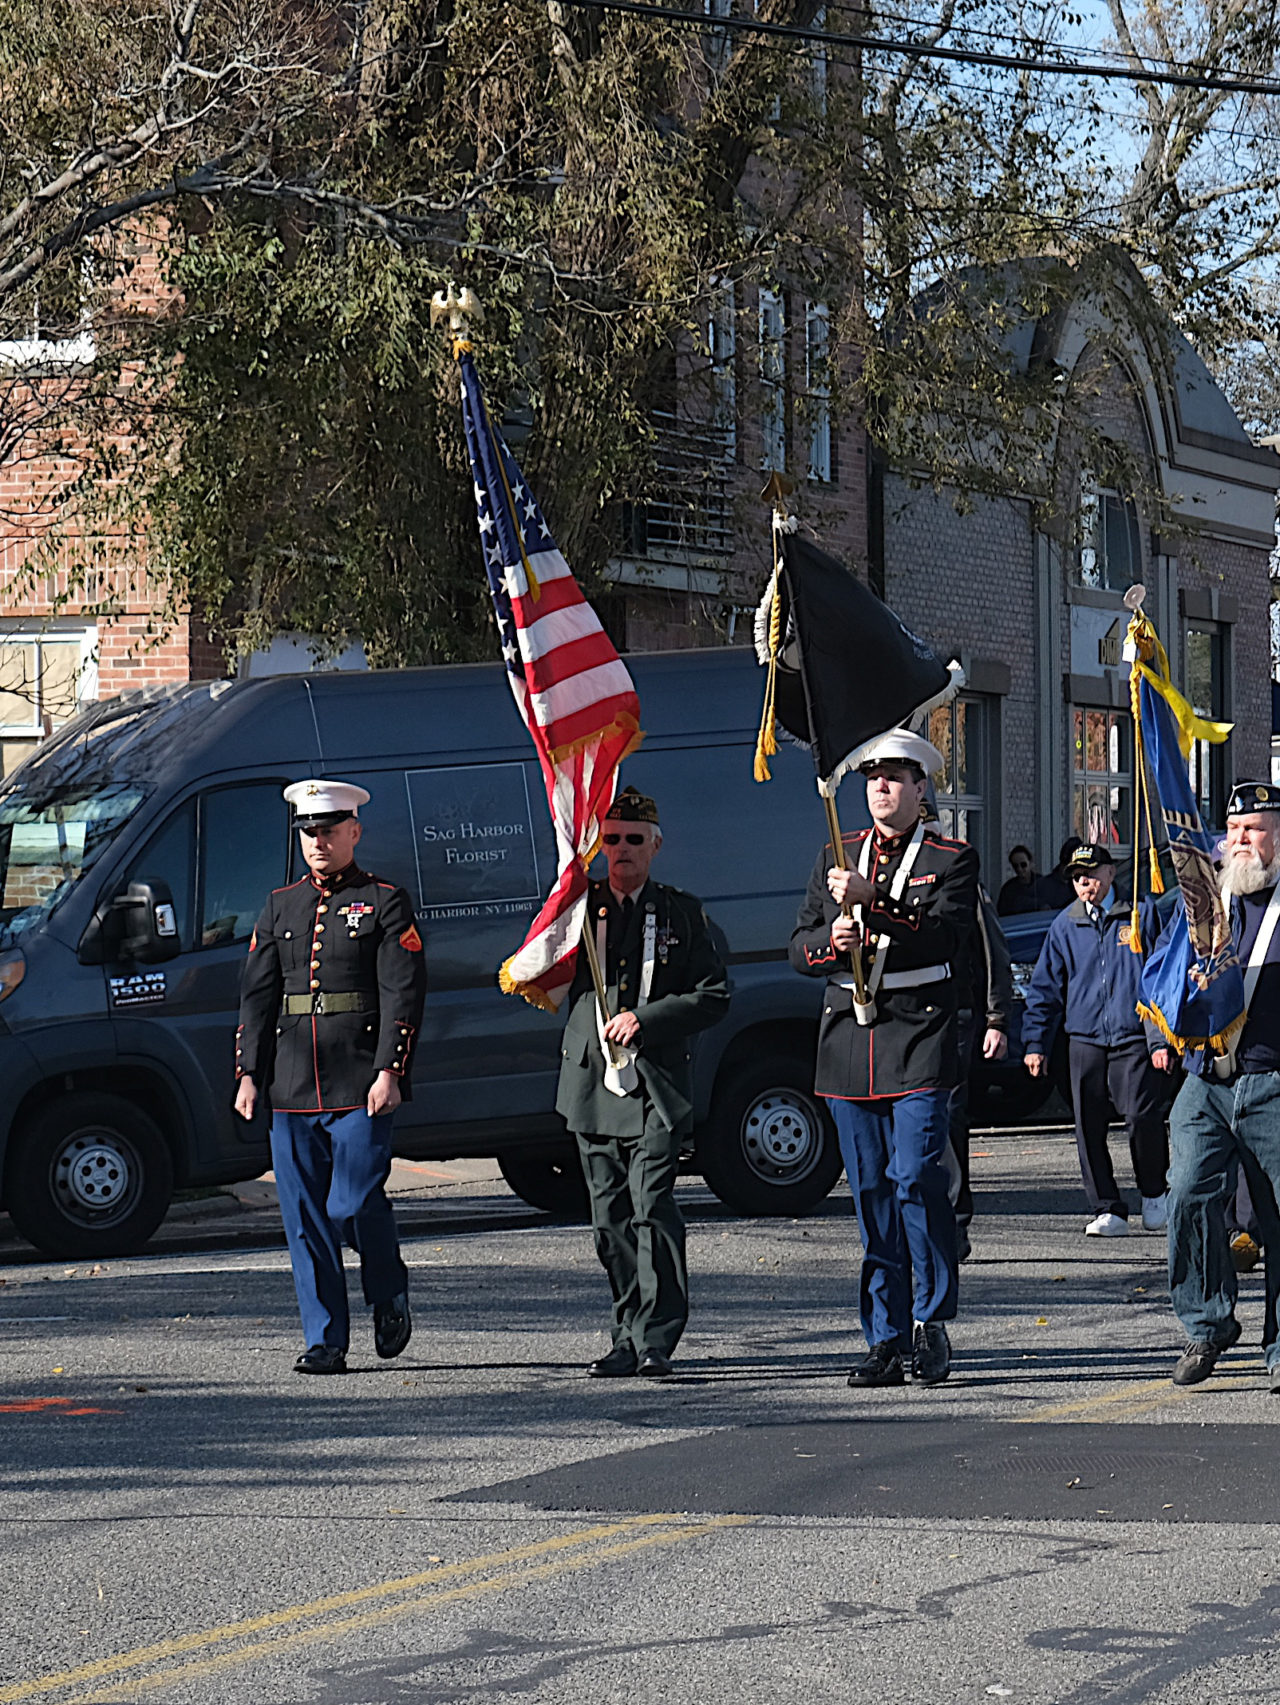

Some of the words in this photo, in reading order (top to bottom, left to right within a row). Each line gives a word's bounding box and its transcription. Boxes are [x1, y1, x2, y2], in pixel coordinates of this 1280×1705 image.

[423, 826, 456, 841] SAG
[460, 822, 524, 839] HARBOR
[445, 847, 507, 864] FLORIST
[430, 906, 480, 920] HARBOR
[485, 904, 501, 915] NY
[505, 902, 533, 913] 11963
[110, 972, 165, 986] RAM
[111, 982, 166, 997] 1500
